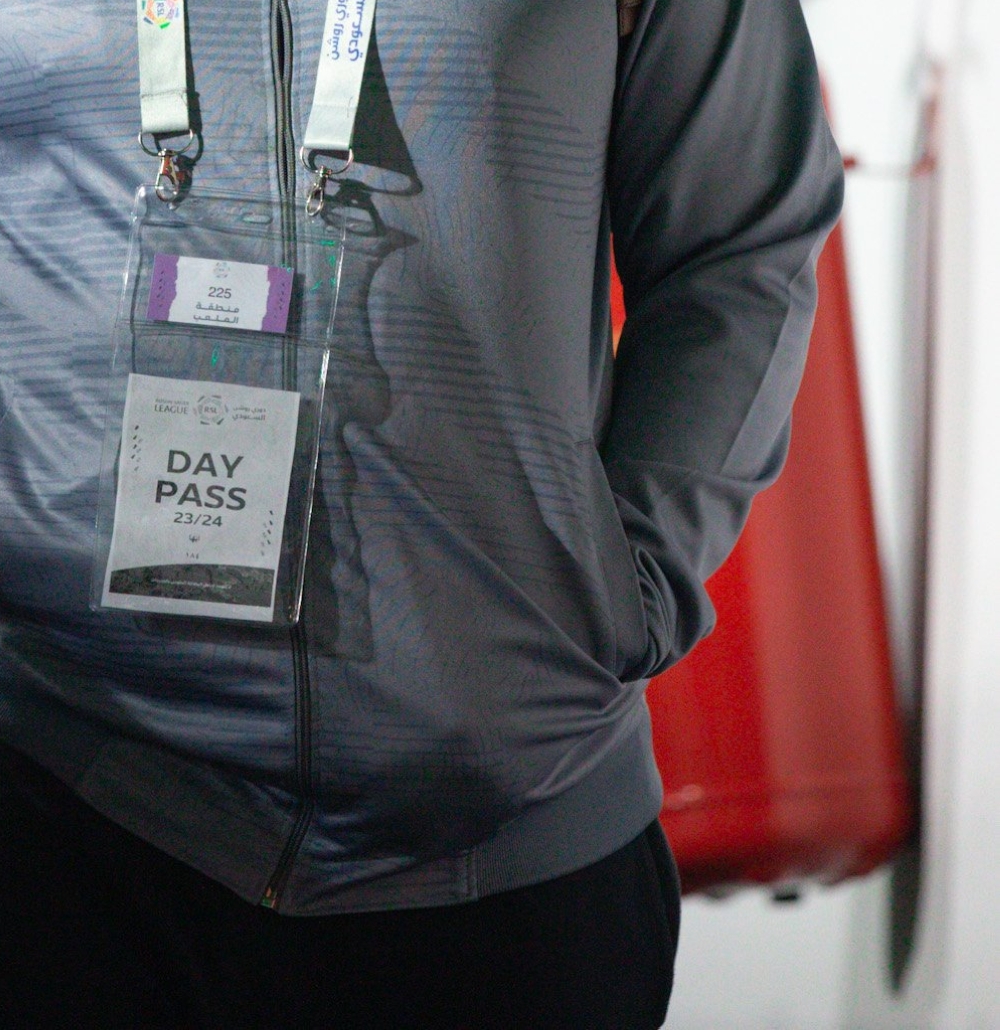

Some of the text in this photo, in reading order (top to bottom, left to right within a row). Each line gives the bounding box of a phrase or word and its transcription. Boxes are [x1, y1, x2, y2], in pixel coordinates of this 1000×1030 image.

[208, 286, 232, 299] 225
[196, 301, 239, 313] منطقة
[154, 404, 189, 414] LEAGUE
[167, 449, 244, 479] DAY
[155, 479, 247, 511] PASS
[173, 511, 223, 527] 23/24
